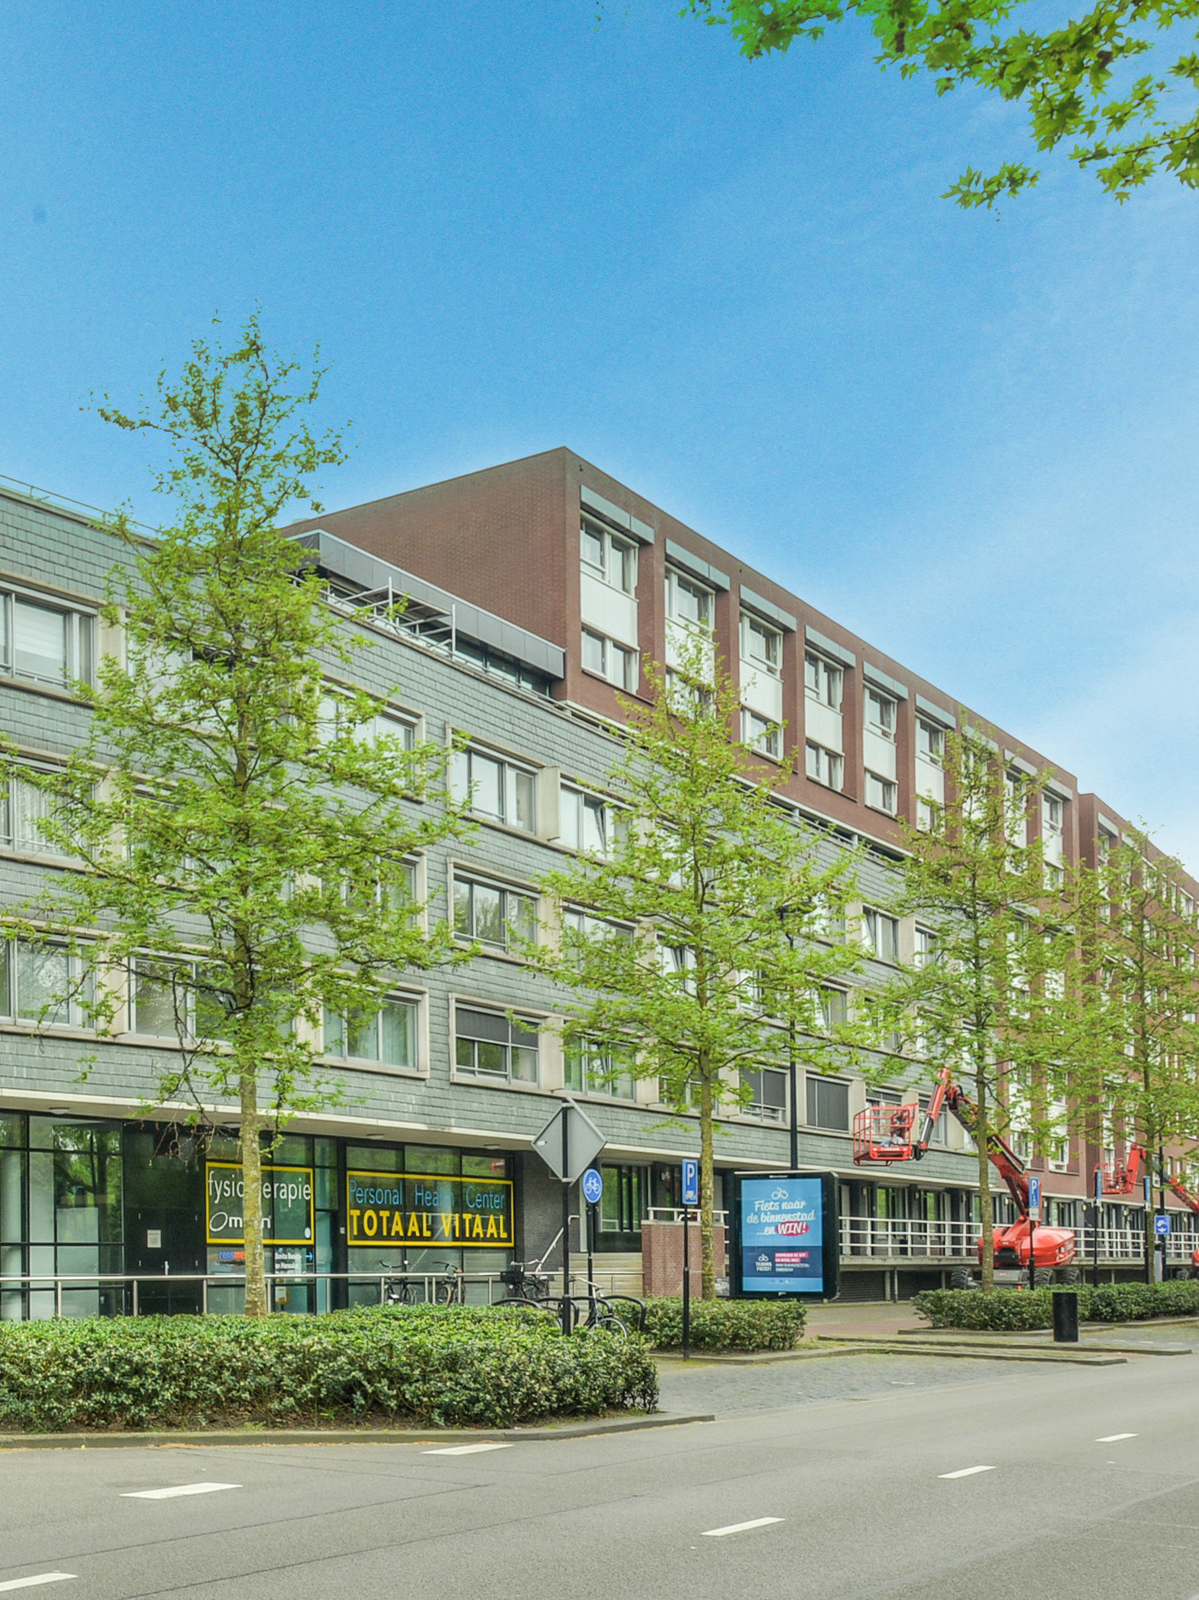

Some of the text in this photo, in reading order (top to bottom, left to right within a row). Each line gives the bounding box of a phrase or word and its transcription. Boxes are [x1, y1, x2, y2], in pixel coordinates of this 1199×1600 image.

[687, 1163, 695, 1186] P
[208, 1170, 311, 1208] fysioerapie
[349, 1180, 505, 1209] Personal Heah Center
[1032, 1180, 1037, 1194] P
[754, 1200, 806, 1212] Fiets naar
[350, 1209, 508, 1239] TOTAAL VITAAL
[747, 1209, 816, 1224] de binnenstad
[778, 1222, 806, 1235] WIN!
